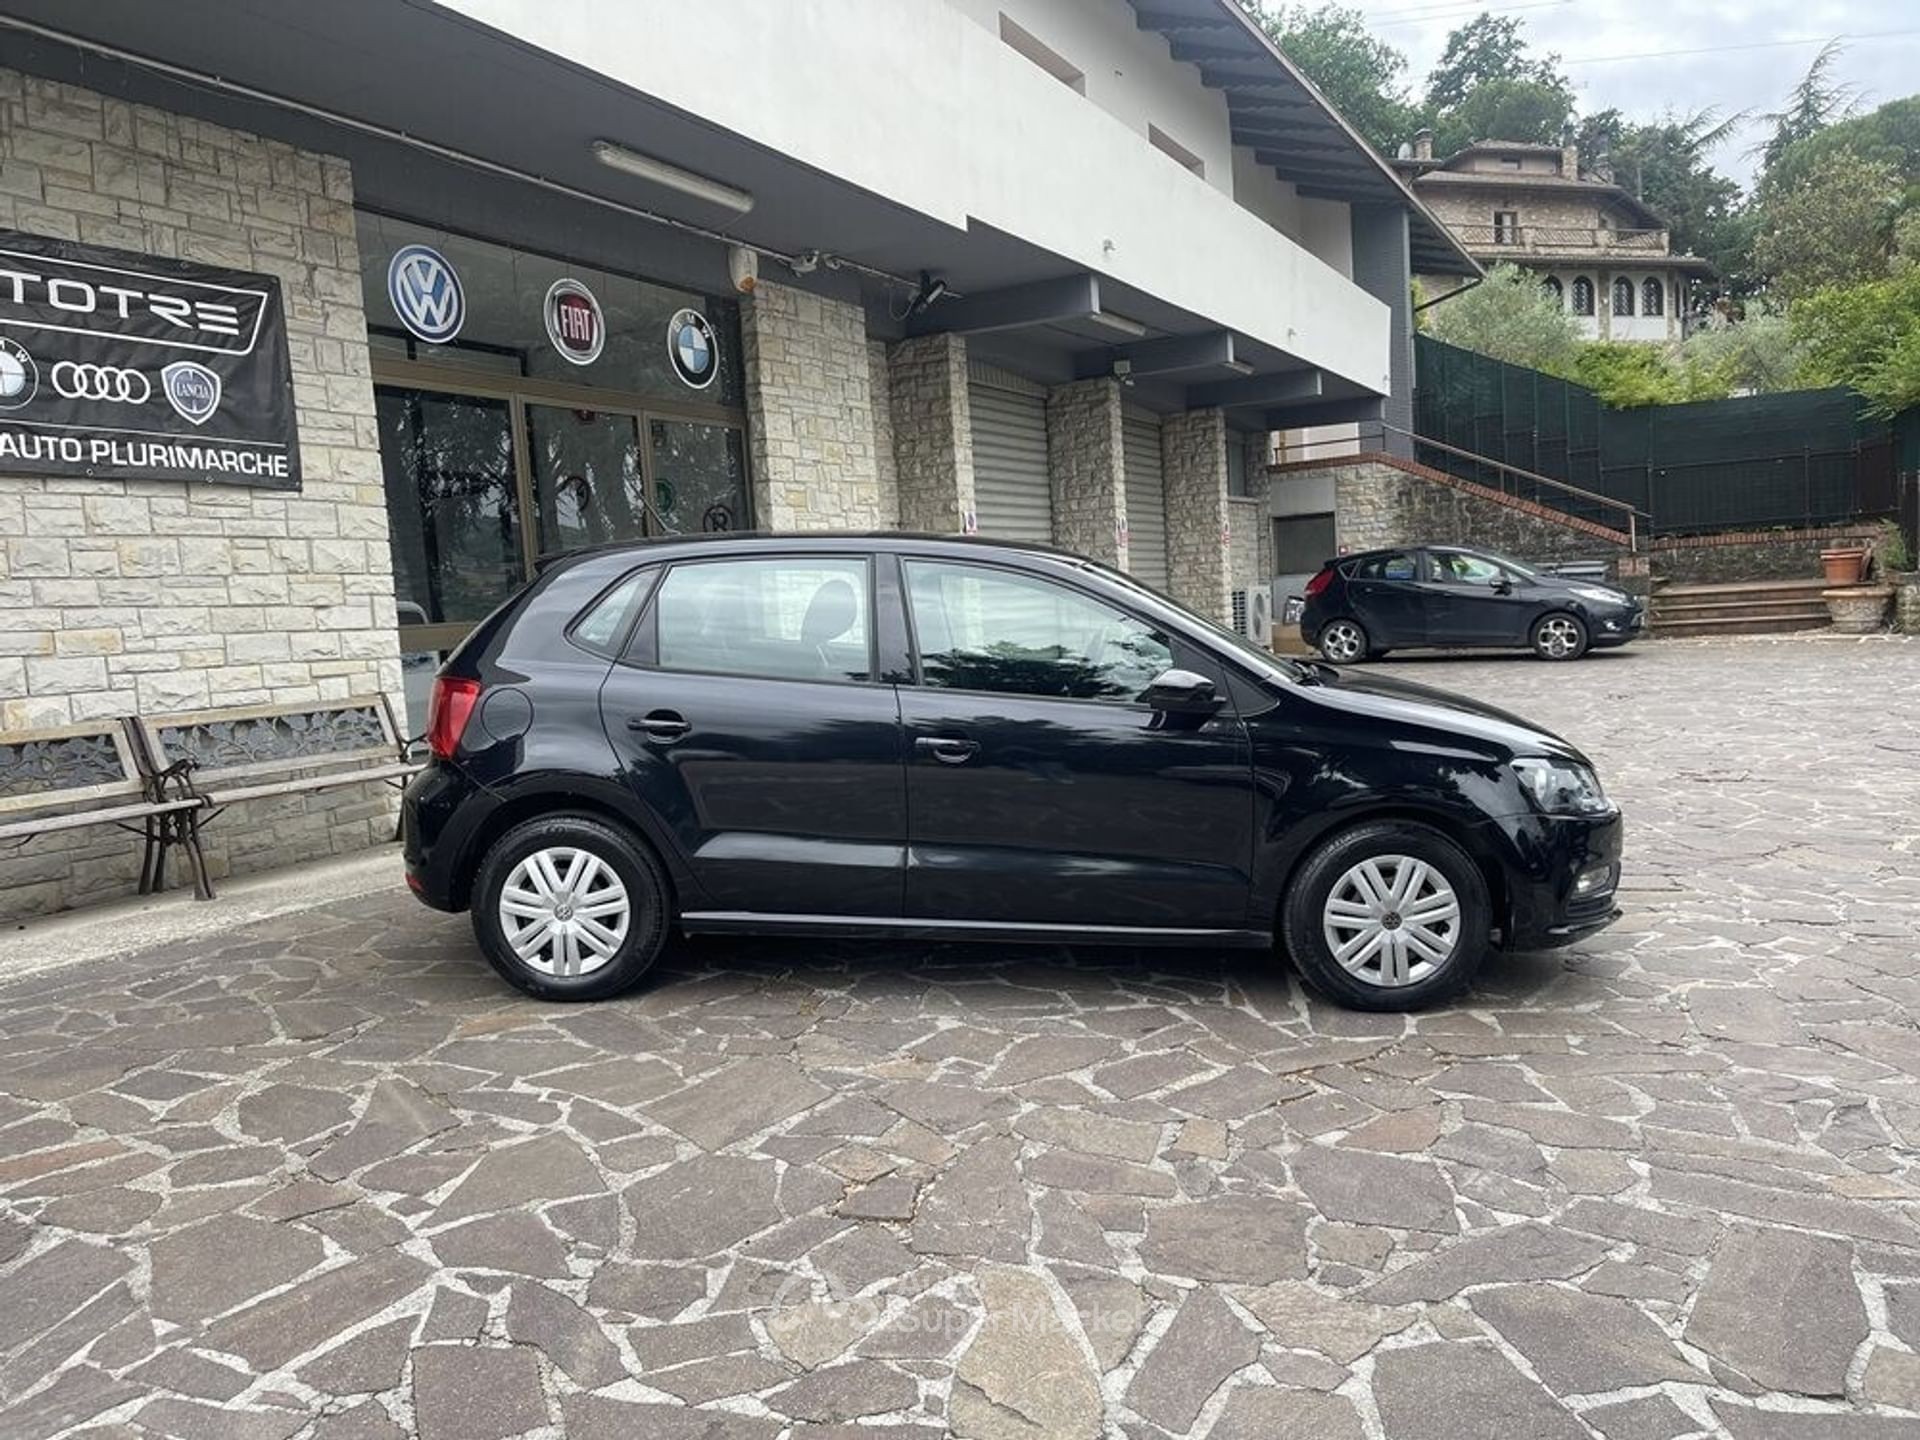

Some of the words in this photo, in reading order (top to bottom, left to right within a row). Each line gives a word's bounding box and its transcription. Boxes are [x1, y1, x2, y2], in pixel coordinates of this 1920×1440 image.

[561, 304, 591, 341] FIAT
[0, 432, 82, 462] AUTO
[90, 439, 289, 478] PLURIMARCHE
